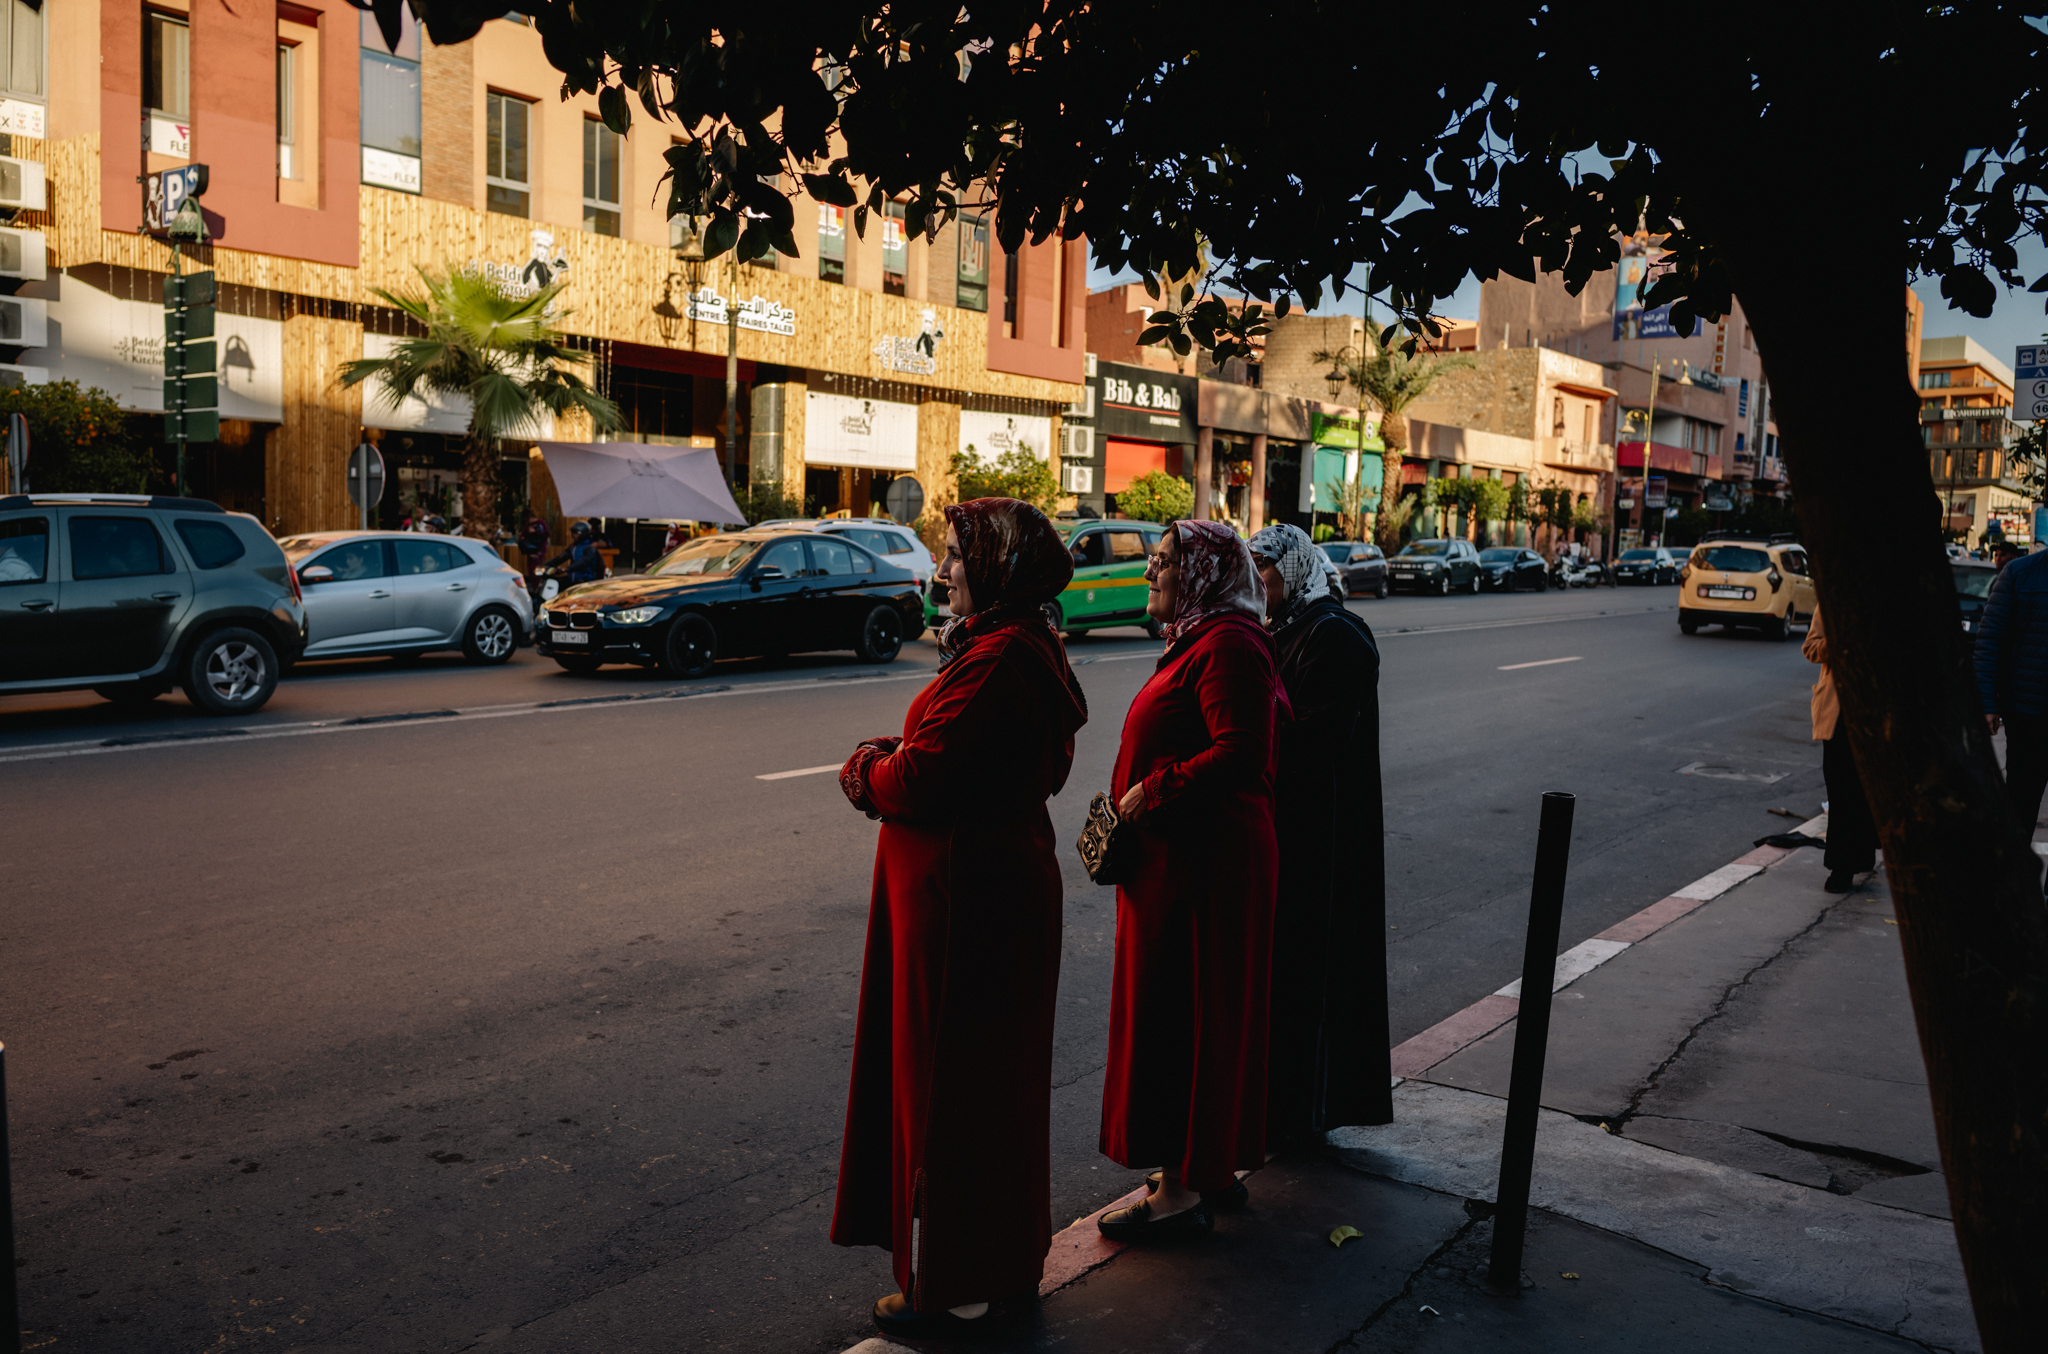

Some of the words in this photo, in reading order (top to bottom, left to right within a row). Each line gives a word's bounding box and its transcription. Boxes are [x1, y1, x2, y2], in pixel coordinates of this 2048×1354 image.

[170, 140, 188, 152] FLE
[394, 172, 417, 185] FLEX
[166, 174, 184, 211] P
[487, 263, 521, 281] Beldi
[766, 301, 794, 322] مركز
[688, 308, 720, 320] CENTRE
[770, 322, 793, 334] TALEB
[132, 336, 158, 348] Beldi
[894, 336, 914, 350] Beldi
[132, 354, 165, 366] Kitche
[894, 348, 922, 361] Fusion
[894, 360, 926, 374] Kitchen
[1102, 376, 1134, 404] Bib
[1134, 382, 1150, 407] &
[1150, 384, 1182, 411] Bab
[2038, 384, 2046, 394] 1
